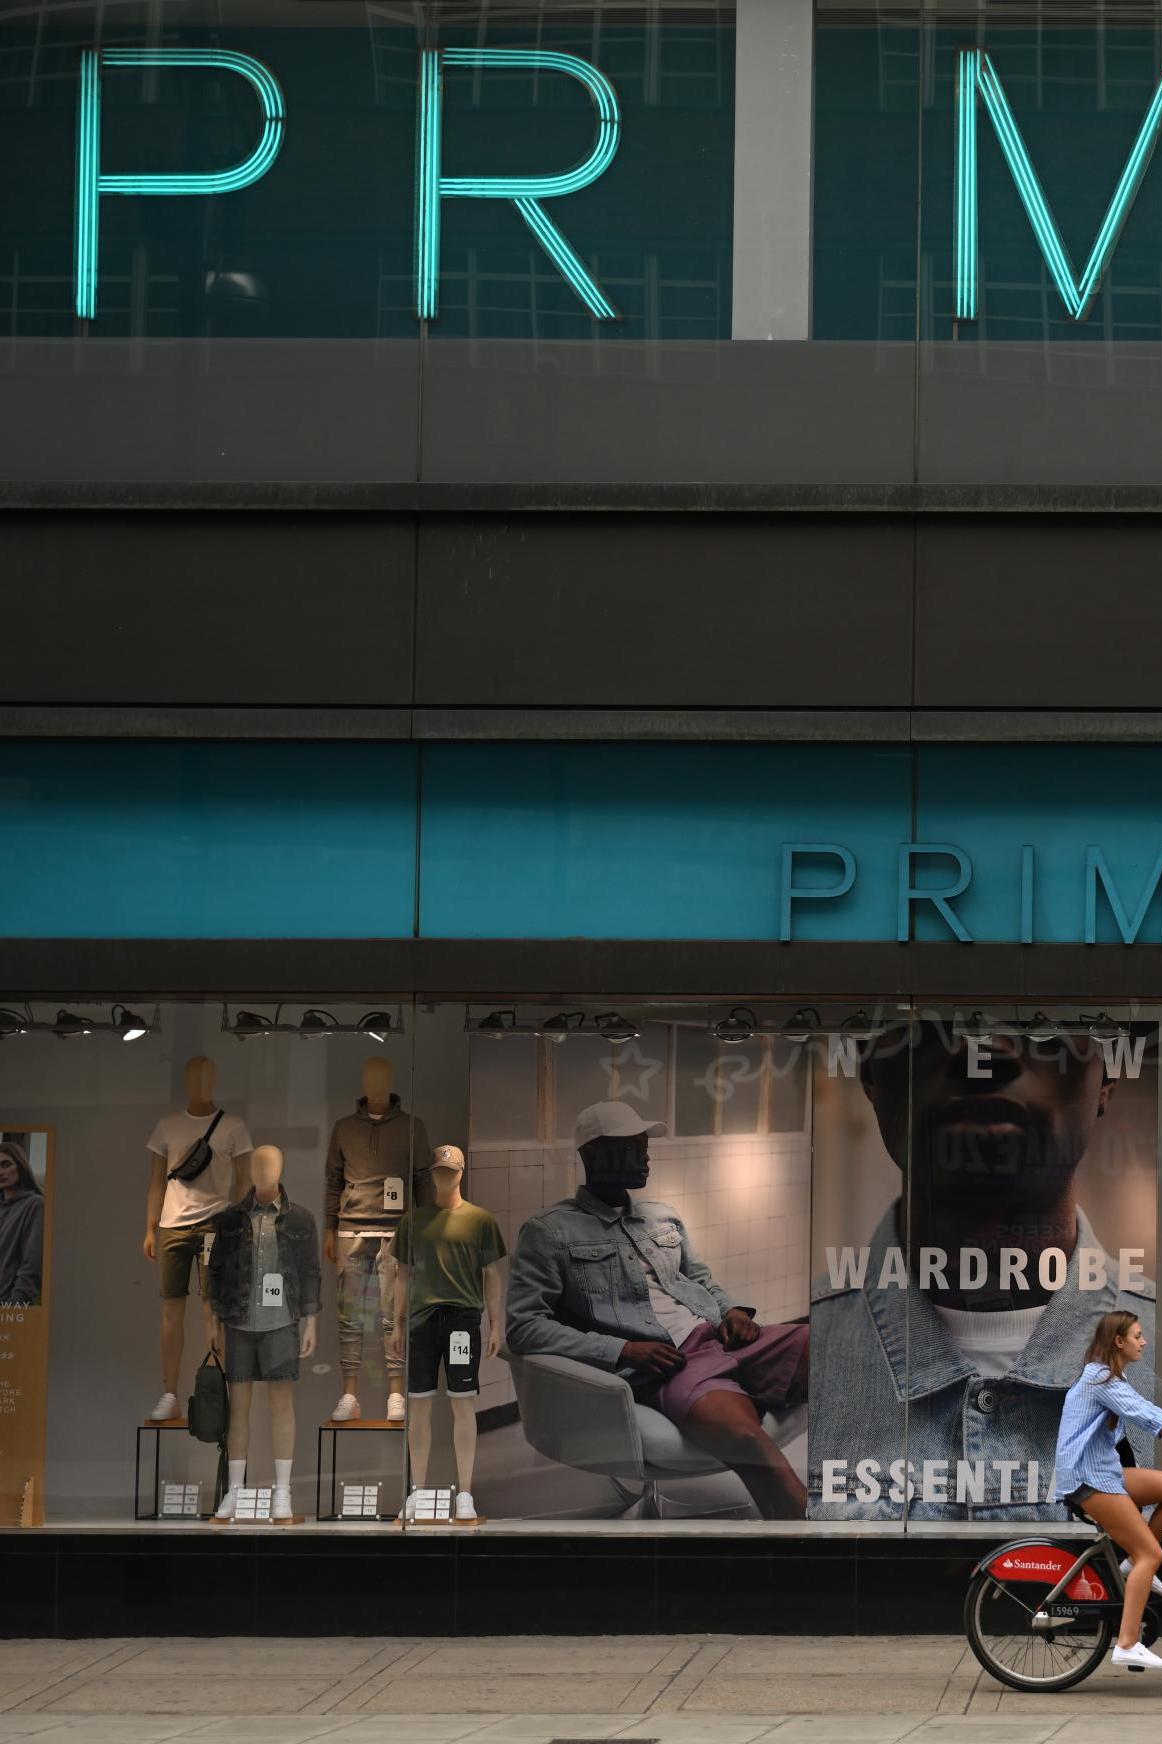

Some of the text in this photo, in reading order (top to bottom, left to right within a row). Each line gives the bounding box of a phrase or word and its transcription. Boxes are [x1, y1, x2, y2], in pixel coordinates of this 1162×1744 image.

[827, 1035, 1147, 1079] NEW
[386, 1191, 398, 1201] £8
[824, 1246, 1146, 1291] WARDROBE
[265, 1287, 280, 1296] £10
[453, 1345, 469, 1356] £14
[821, 1459, 1057, 1504] ESSENTI
[1014, 1559, 1062, 1571] Santander
